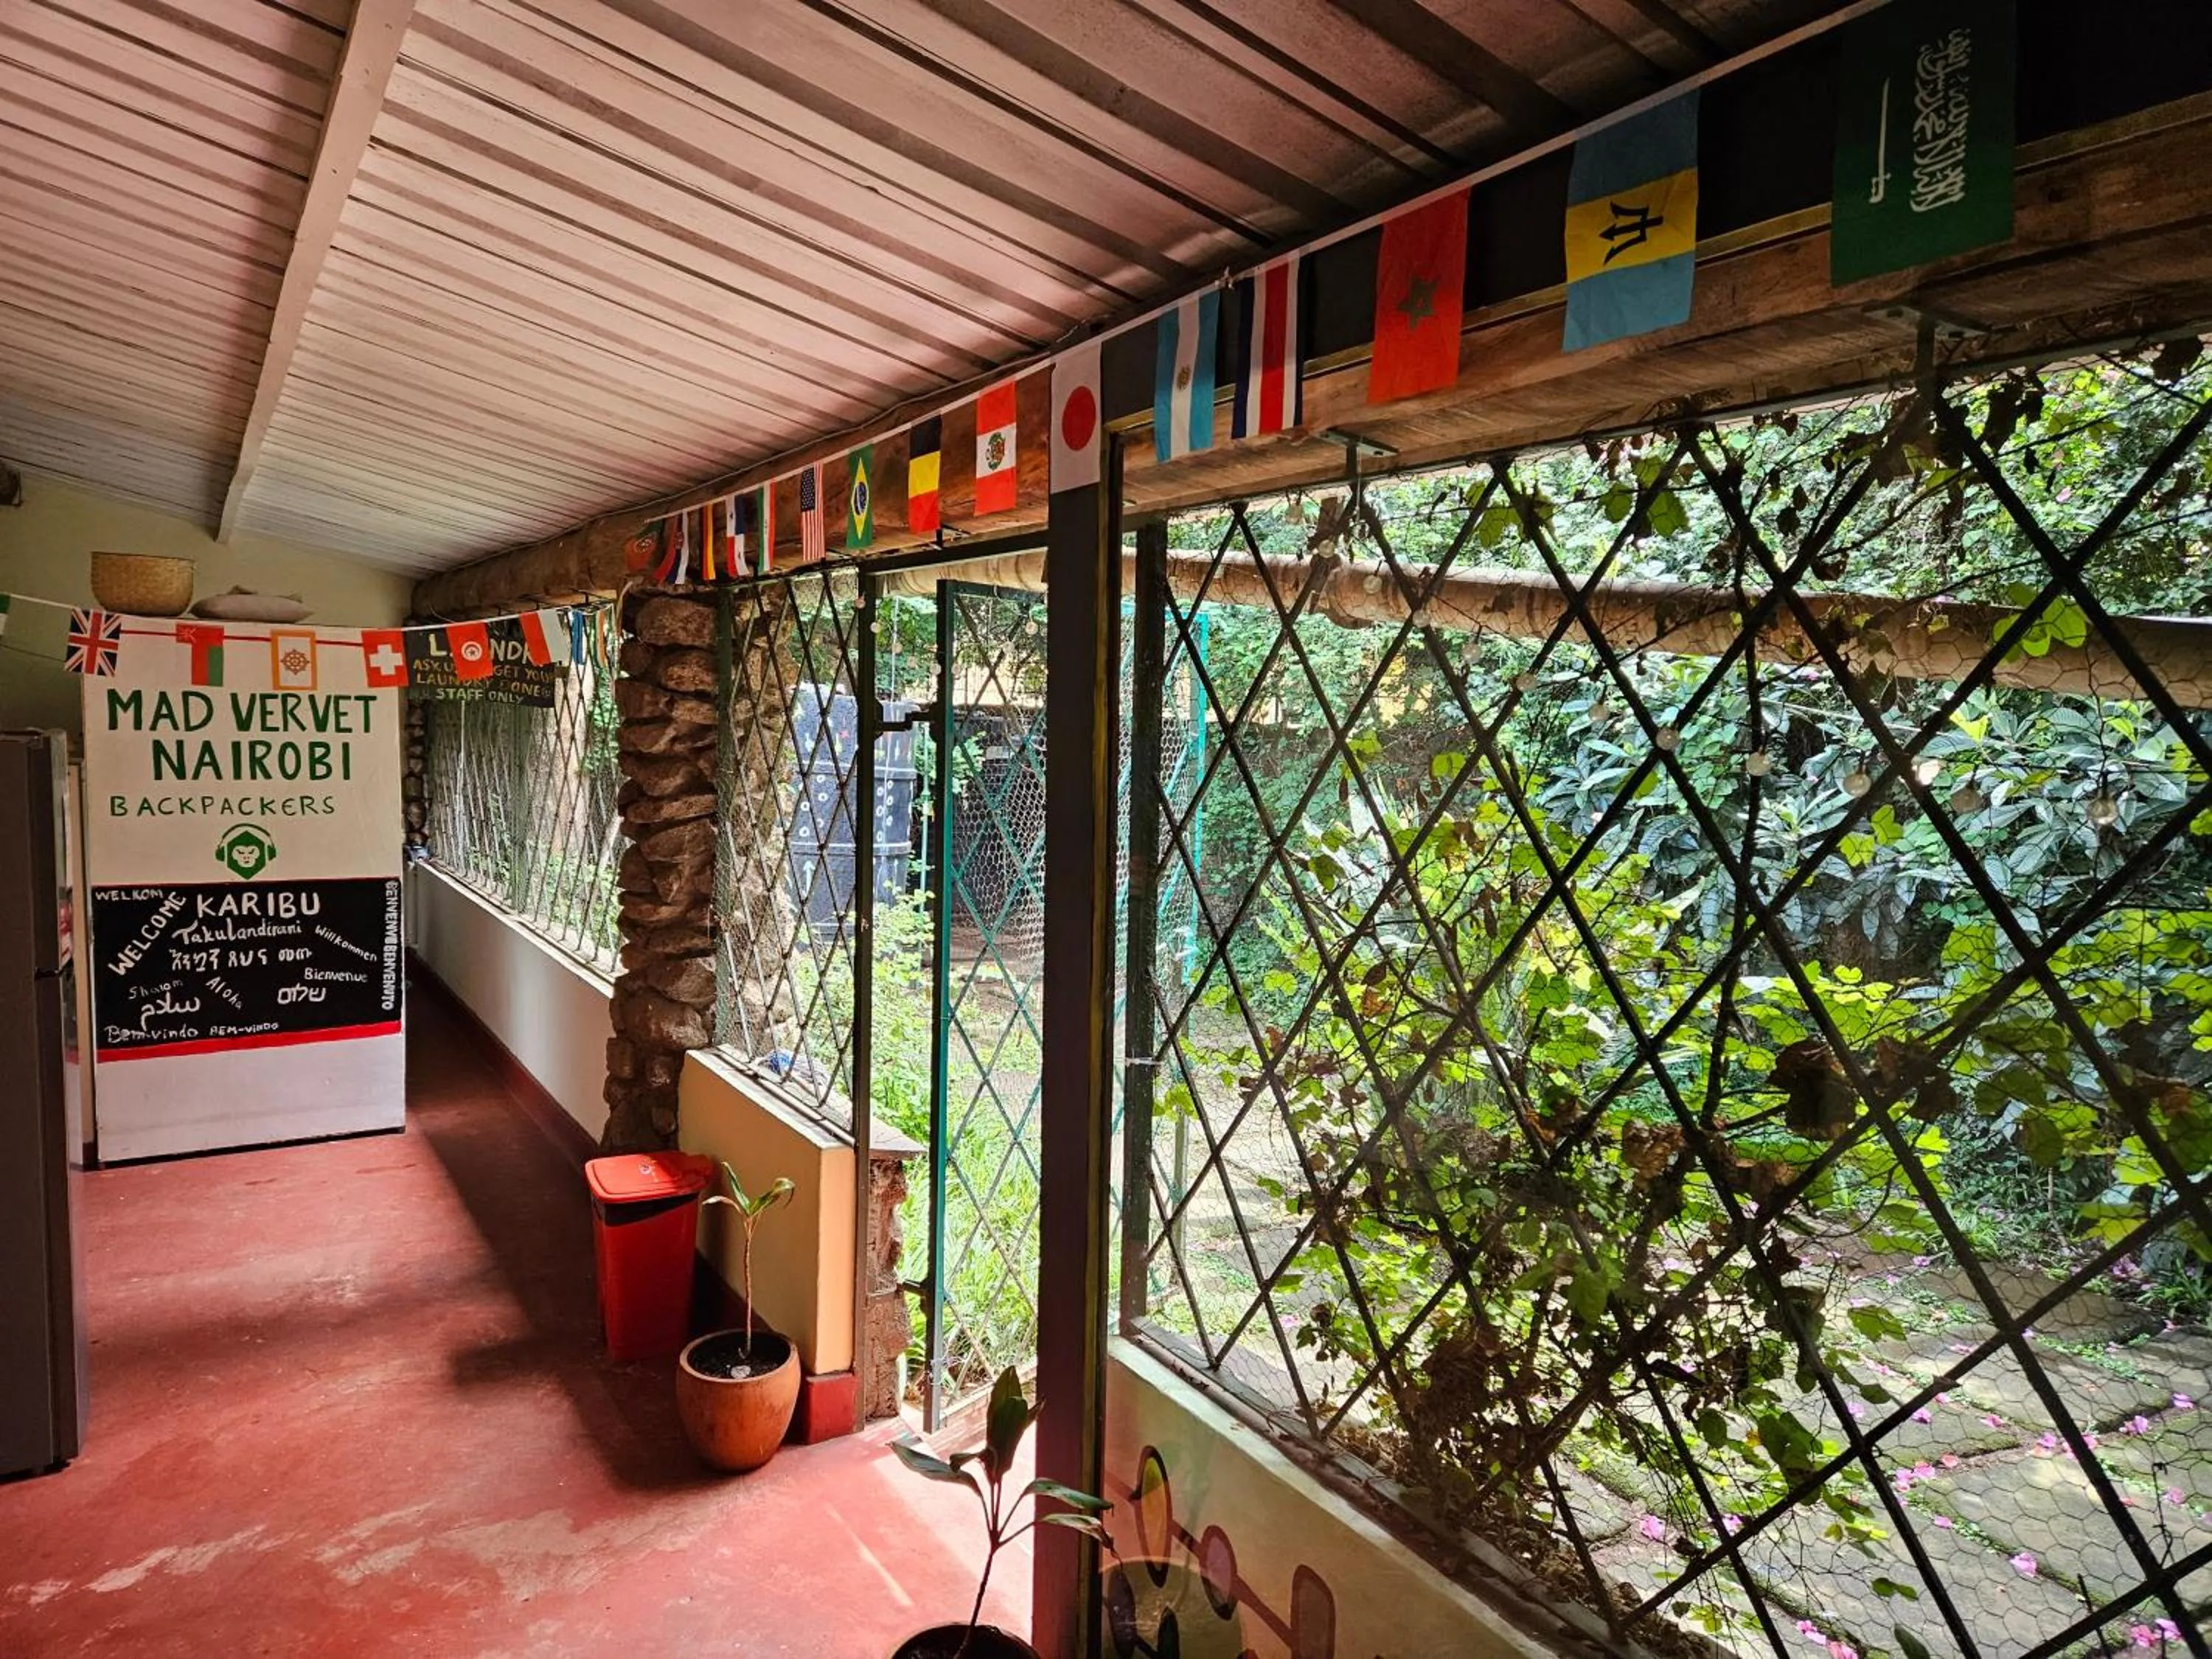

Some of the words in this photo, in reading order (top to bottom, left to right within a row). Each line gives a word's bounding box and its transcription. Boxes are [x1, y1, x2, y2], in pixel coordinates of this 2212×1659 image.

[495, 665, 521, 677] GET
[436, 688, 484, 701] STAFF
[489, 691, 524, 703] ONLY
[107, 689, 214, 731] MAD
[230, 692, 378, 733] VERVET
[152, 740, 350, 780] NAIROBI
[110, 795, 335, 816] BACKPACKERS
[95, 888, 164, 901] WELKOM
[197, 892, 320, 918] KARIBU
[108, 891, 187, 975] WELCOME
[172, 917, 302, 945] Takulandirani
[315, 925, 377, 961] Willkommen
[305, 967, 368, 983] Bienvenue
[206, 976, 243, 1010] Aloha
[277, 983, 326, 1004] שלום
[141, 991, 201, 1031] سلام
